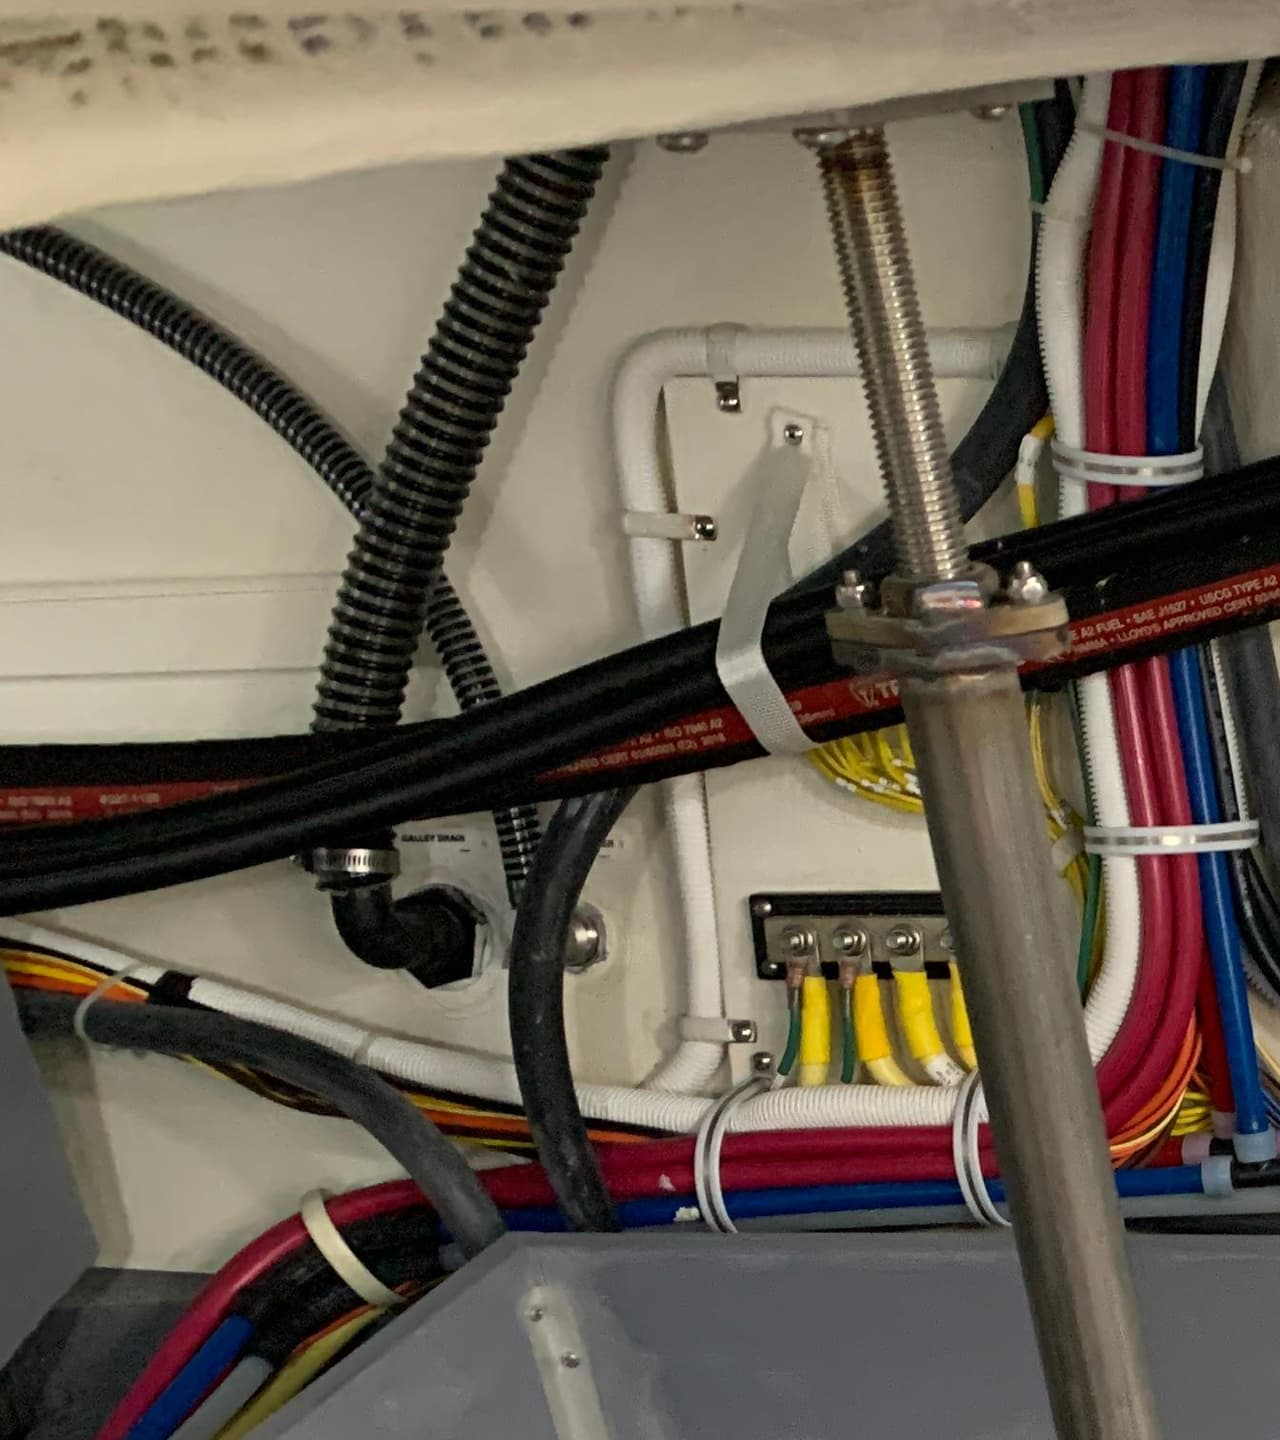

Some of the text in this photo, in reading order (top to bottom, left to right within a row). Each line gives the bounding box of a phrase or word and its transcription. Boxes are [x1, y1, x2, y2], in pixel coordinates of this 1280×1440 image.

[1080, 625, 1095, 638] A2
[1095, 618, 1124, 633] FUEL
[1132, 608, 1155, 624] SAE
[1198, 587, 1232, 605] USCG
[1231, 578, 1262, 594] TYPE
[1263, 574, 1278, 587] A2
[1162, 606, 1222, 629] APPROVED
[1222, 596, 1253, 613] CERT
[401, 834, 435, 843] GALLEY
